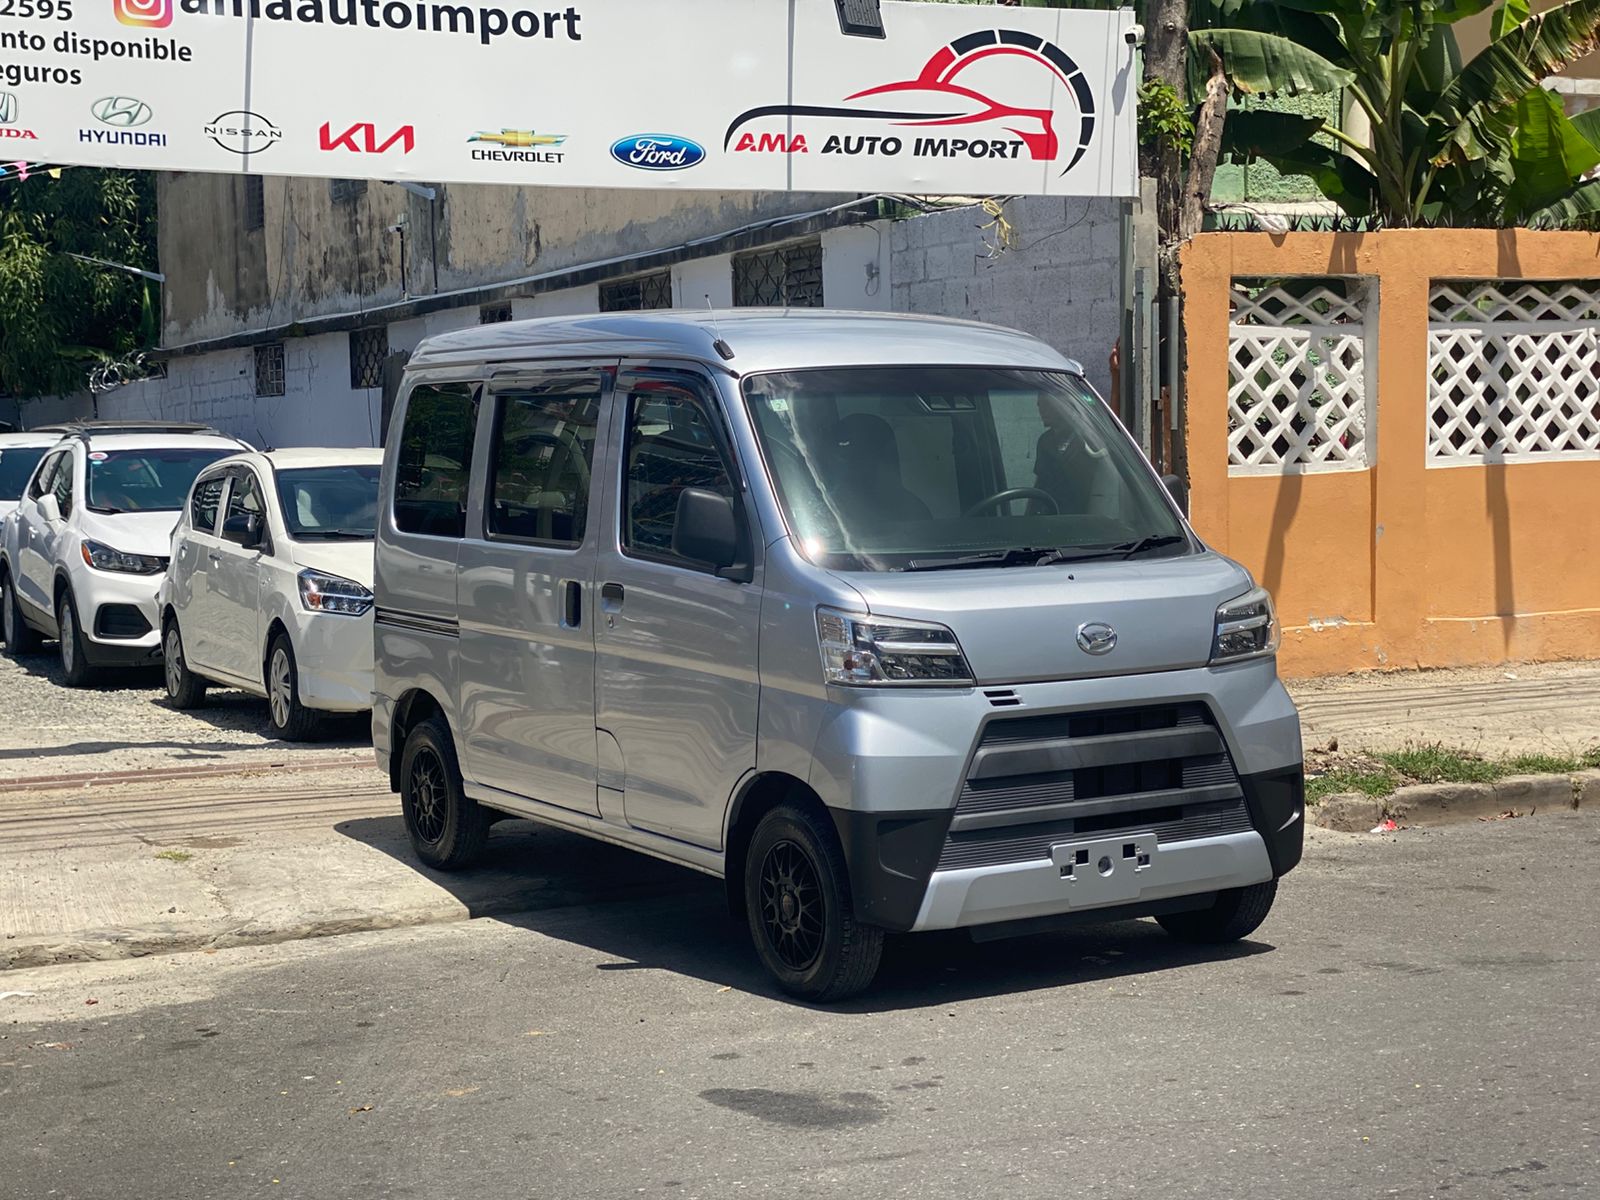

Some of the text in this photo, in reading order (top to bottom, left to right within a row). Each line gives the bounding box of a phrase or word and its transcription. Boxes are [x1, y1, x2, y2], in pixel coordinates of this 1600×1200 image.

[1, 30, 192, 62] nto disponible
[0, 64, 82, 87] guros
[0, 128, 38, 140] DA
[79, 129, 167, 147] HYUNDAI
[204, 126, 282, 138] NISSAN
[319, 121, 414, 154] KIA
[471, 149, 564, 164] CHEVROLET
[629, 141, 688, 166] Ford
[735, 133, 1024, 160] AMA AUTO IMPORT
